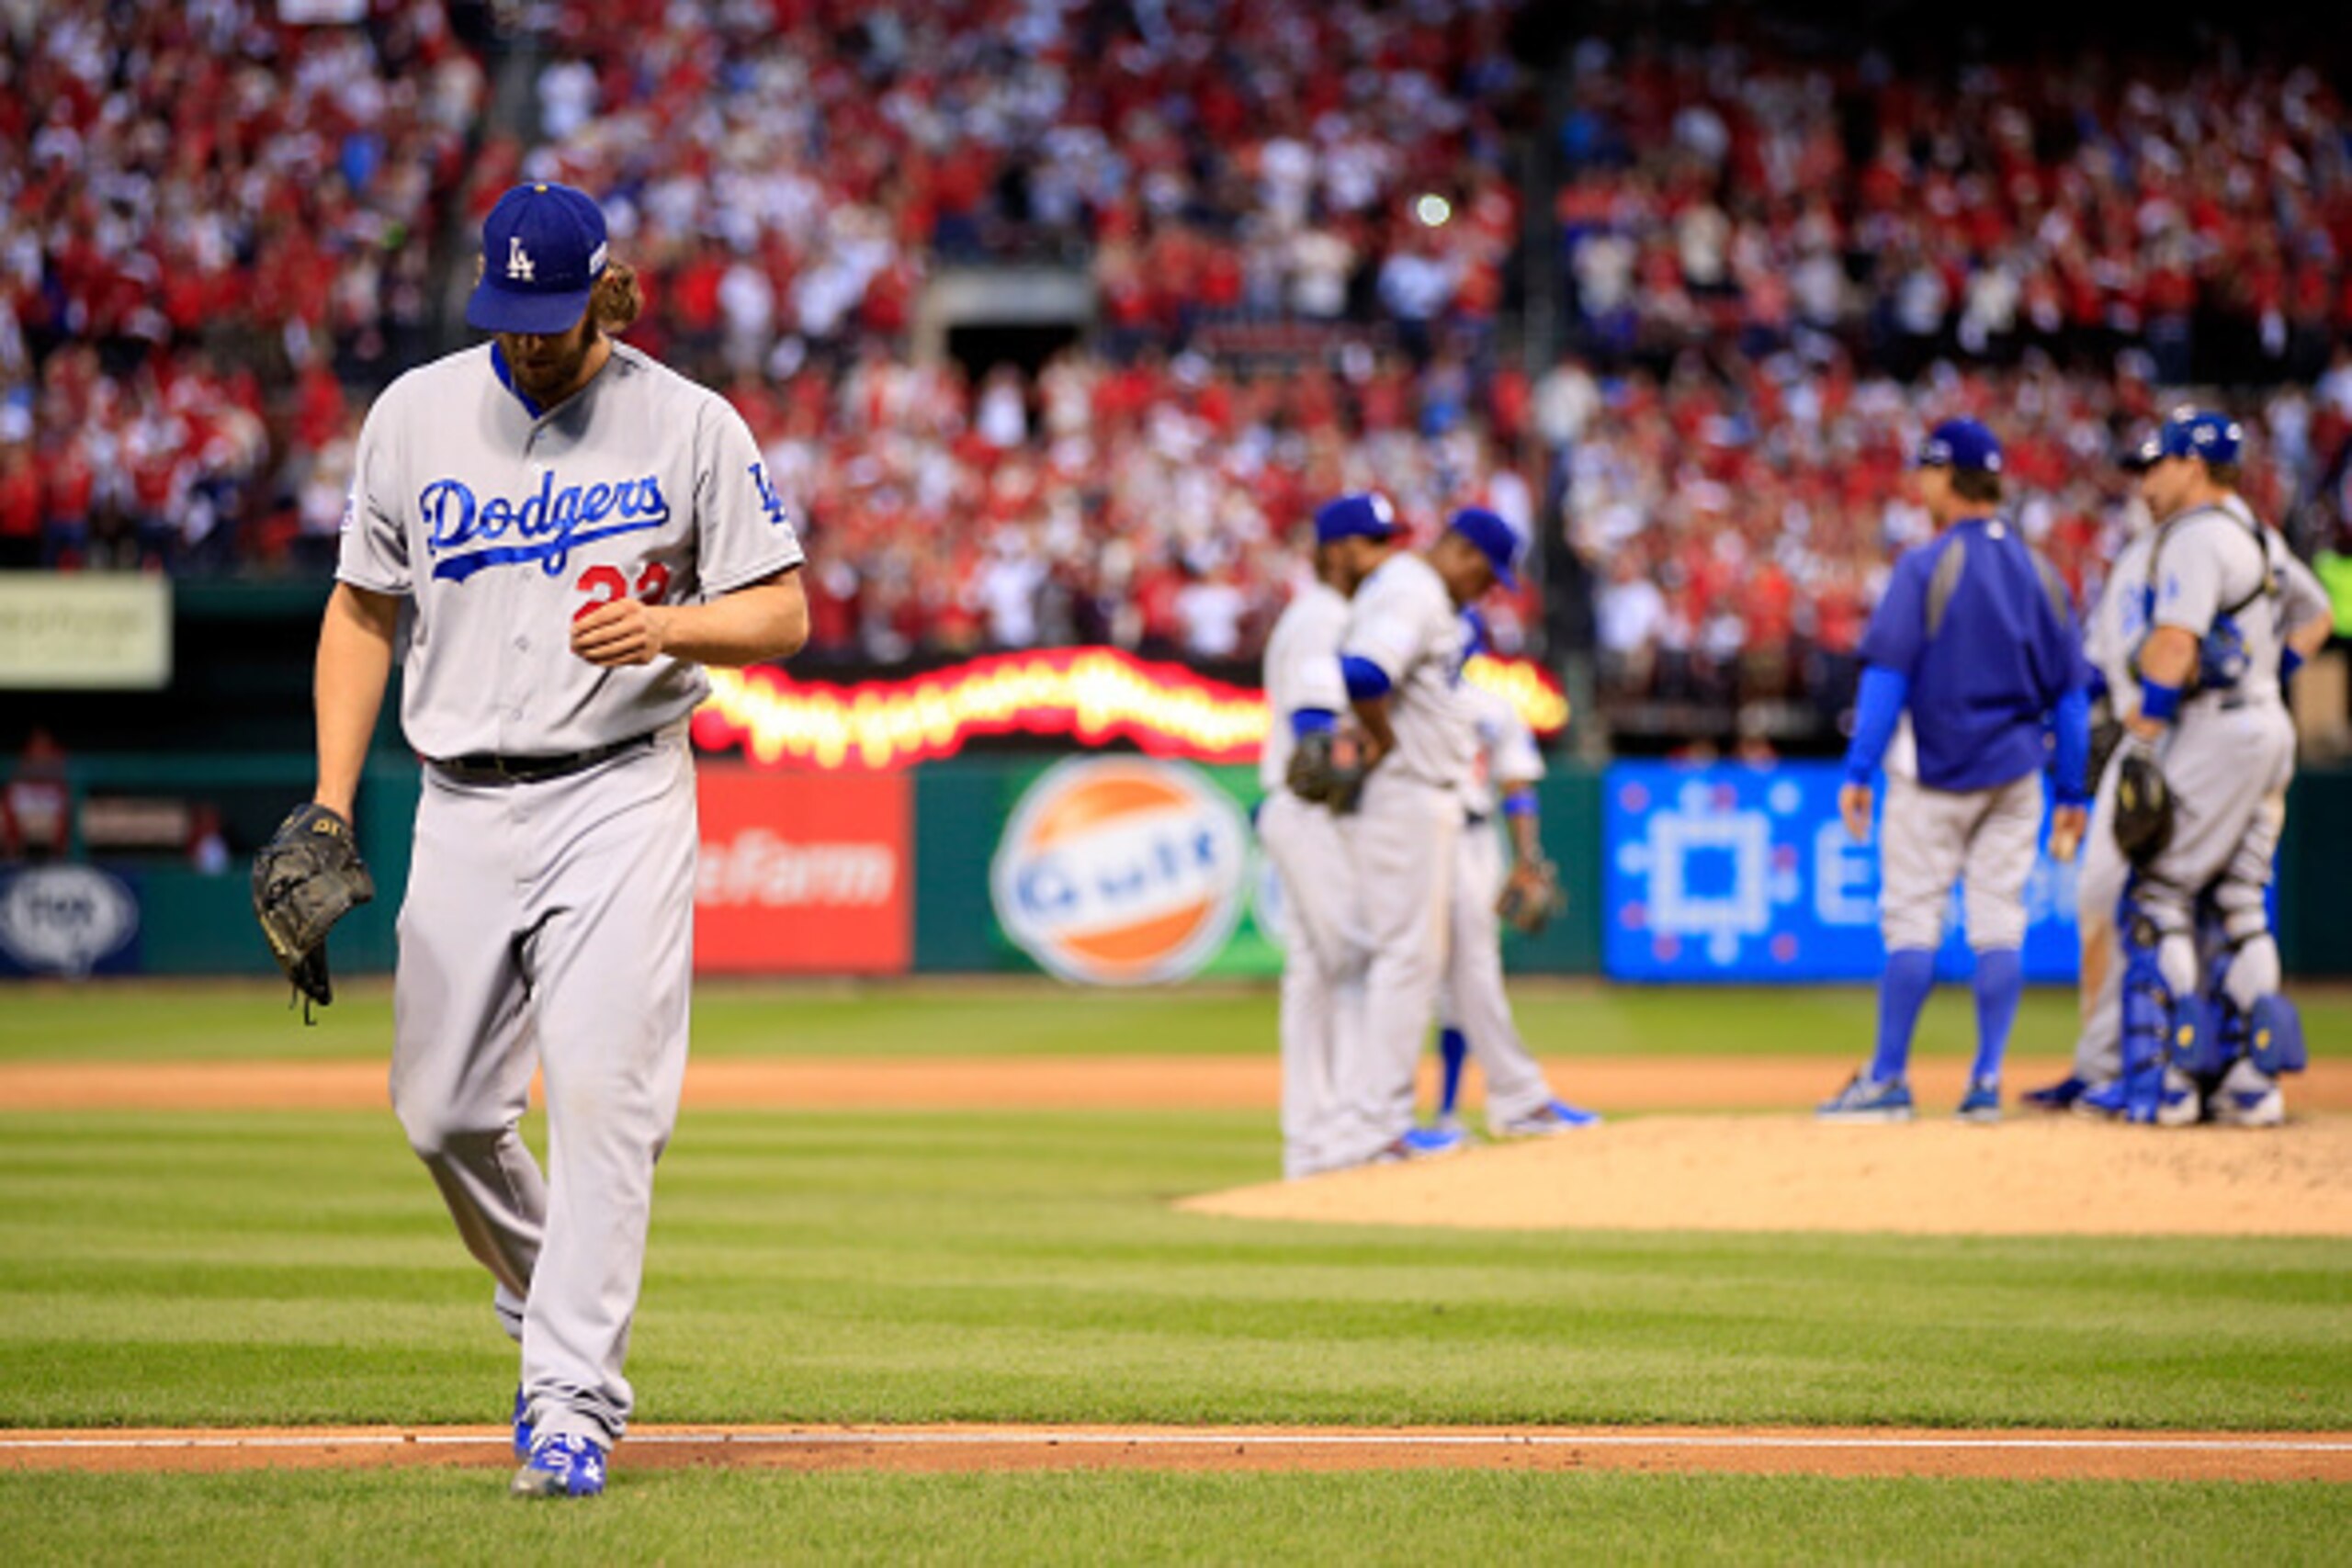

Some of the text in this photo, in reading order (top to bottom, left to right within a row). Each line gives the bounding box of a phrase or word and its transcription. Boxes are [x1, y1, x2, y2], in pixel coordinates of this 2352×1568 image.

[506, 237, 535, 281] LA
[419, 470, 669, 579] Dodgers
[1016, 829, 1217, 912] Gulf
